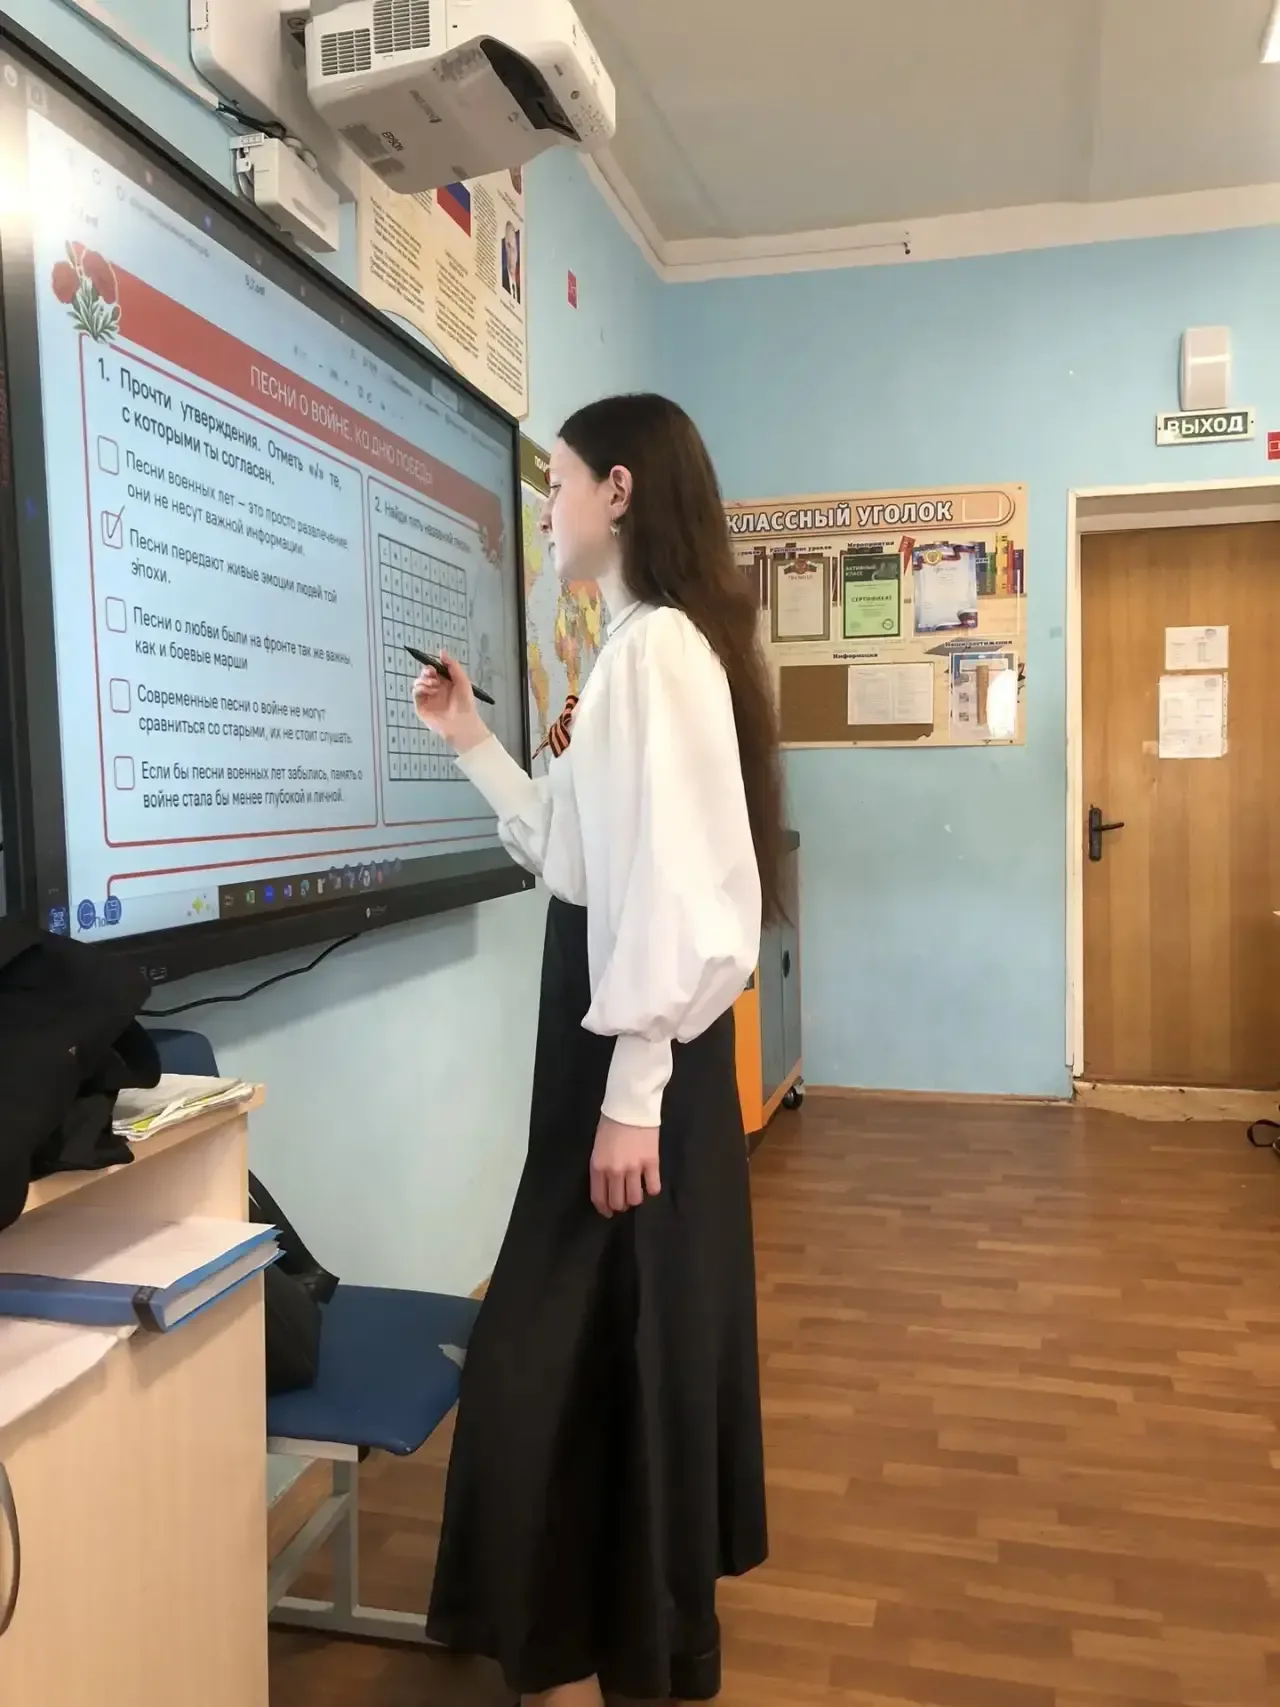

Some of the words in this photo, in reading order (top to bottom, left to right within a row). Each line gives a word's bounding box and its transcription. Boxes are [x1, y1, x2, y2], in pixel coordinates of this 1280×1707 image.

[98, 357, 110, 381] 1.
[120, 367, 172, 410] Прочти
[181, 401, 261, 451] утверждения.
[268, 440, 303, 472] Отметь
[329, 472, 342, 491] те,
[251, 365, 297, 409] ПЕСНИ
[300, 394, 309, 416] О
[311, 400, 353, 441] ВОЙНЕ.
[355, 426, 369, 449] КО
[372, 436, 395, 463] ДНЮ
[398, 449, 432, 484] ПОБЕДЫ
[1167, 415, 1244, 435] ВЫХОД
[122, 407, 130, 423] с
[134, 412, 200, 454] которыми
[204, 441, 218, 462] ты
[222, 451, 275, 485] согласен.
[126, 450, 165, 481] Песни
[168, 471, 215, 497] военных
[218, 490, 234, 505] лет
[248, 502, 264, 518] это
[266, 508, 296, 530] просто
[127, 484, 150, 503] они
[154, 493, 168, 509] не
[172, 499, 202, 523] несут
[205, 511, 244, 535] важной
[246, 524, 305, 556] информации.
[727, 503, 850, 533] КЛАССНЫЙ
[857, 501, 953, 527] УГОЛОК
[130, 528, 168, 556] Песни
[171, 545, 224, 572] передают
[227, 562, 259, 581] живые
[261, 572, 294, 593] эмоции
[296, 582, 323, 601] людей
[324, 589, 337, 604] той
[131, 561, 171, 584] эпохи.
[133, 606, 172, 631] Песни
[175, 619, 182, 632] о
[185, 621, 220, 640] любви
[221, 625, 248, 645] были
[250, 635, 261, 648] на
[263, 634, 296, 655] фронте
[297, 644, 311, 657] так
[313, 647, 324, 660] же
[135, 640, 156, 656] как
[169, 641, 211, 664] боевые
[214, 653, 248, 672] марши
[137, 684, 218, 709] Современные
[220, 697, 251, 713] песни
[252, 701, 259, 713] о
[261, 700, 288, 716] войне
[290, 704, 301, 718] не
[302, 708, 326, 722] могут
[139, 717, 205, 736] сравниться
[208, 722, 220, 735] со
[222, 723, 268, 741] старыми,
[270, 727, 281, 740] их
[283, 728, 293, 739] не
[295, 729, 318, 741] стоит
[141, 761, 171, 780] Если
[173, 762, 189, 780] бы
[193, 766, 224, 779] песни
[227, 767, 268, 780] военных
[271, 768, 285, 780] лет
[287, 765, 329, 783] забылись,
[331, 769, 358, 780] память
[143, 789, 179, 808] войне
[182, 793, 213, 807] стала
[215, 788, 229, 806] бы
[232, 792, 262, 805] менее
[265, 788, 305, 807] глубокой
